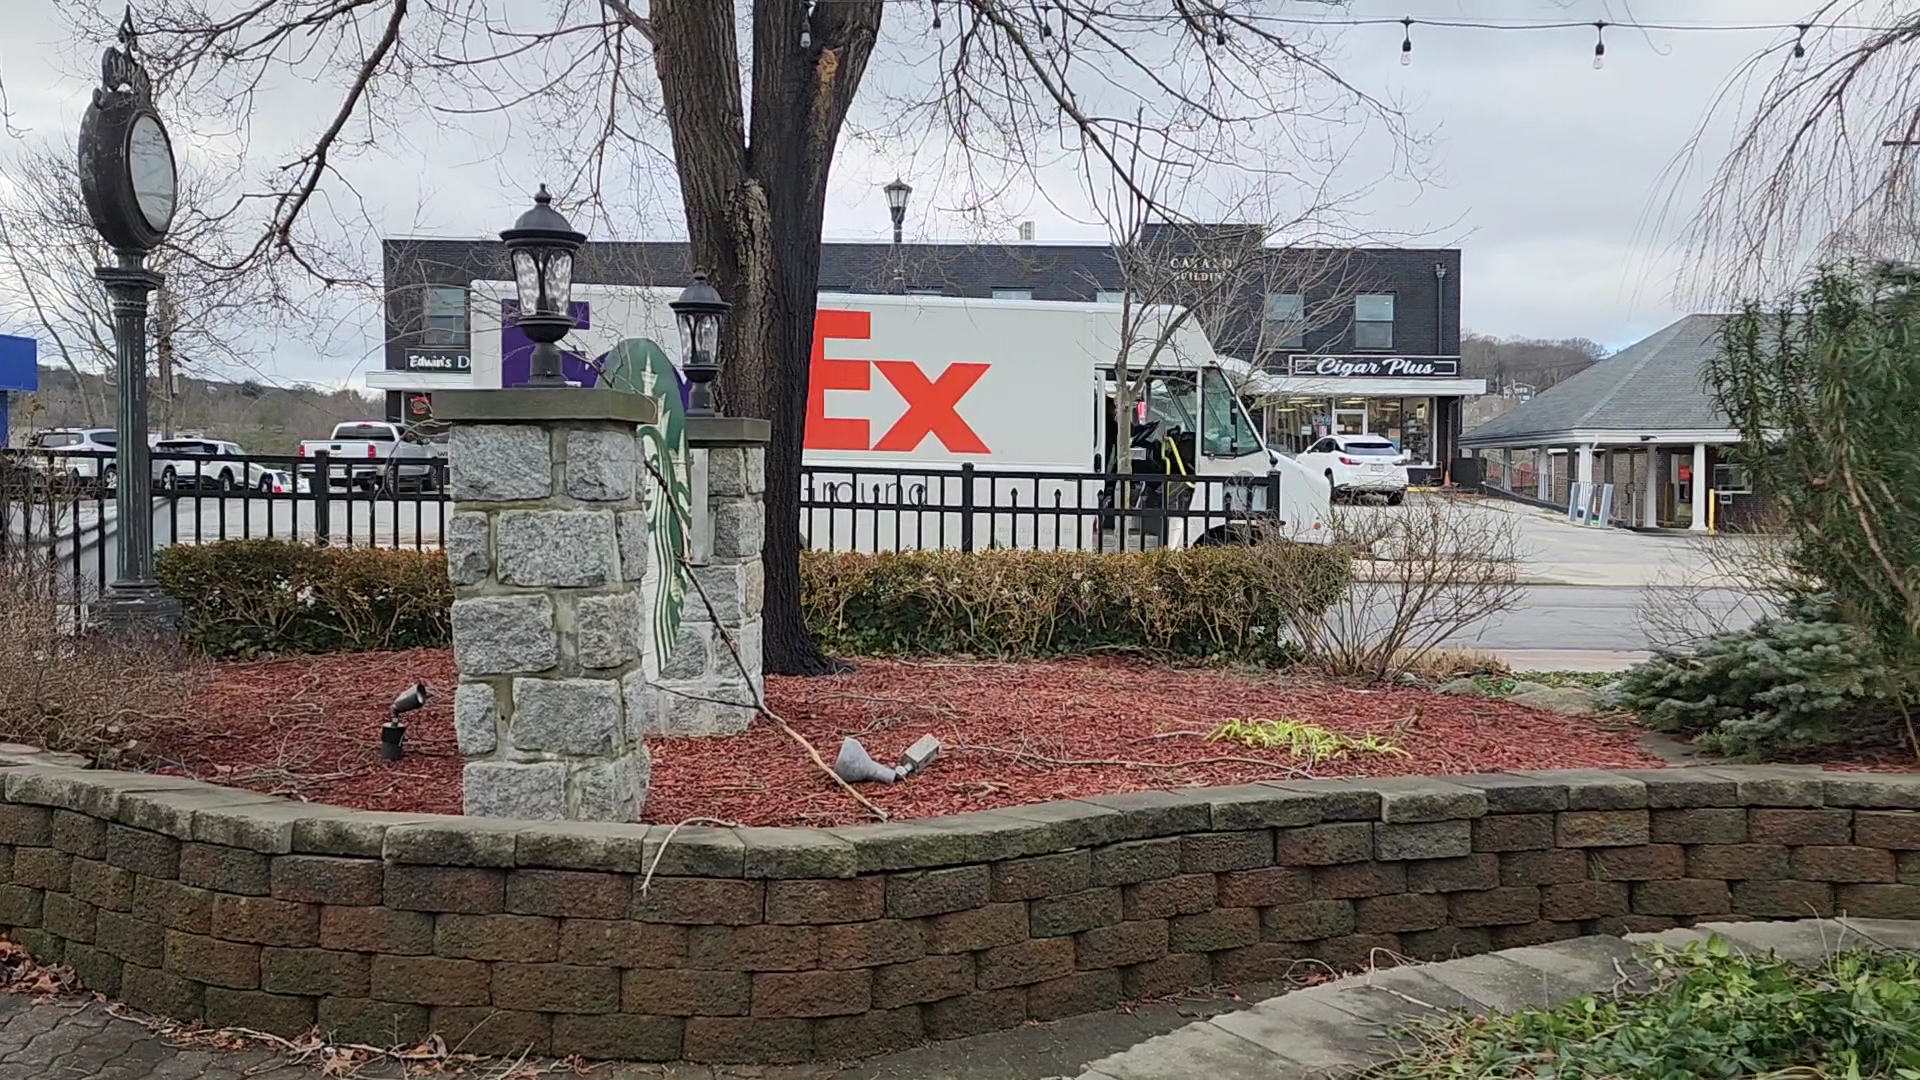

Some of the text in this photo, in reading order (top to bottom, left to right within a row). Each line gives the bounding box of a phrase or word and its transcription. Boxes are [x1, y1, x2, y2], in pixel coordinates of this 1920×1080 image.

[409, 355, 452, 368] Edwin's
[1316, 358, 1435, 377] Cigar Plus
